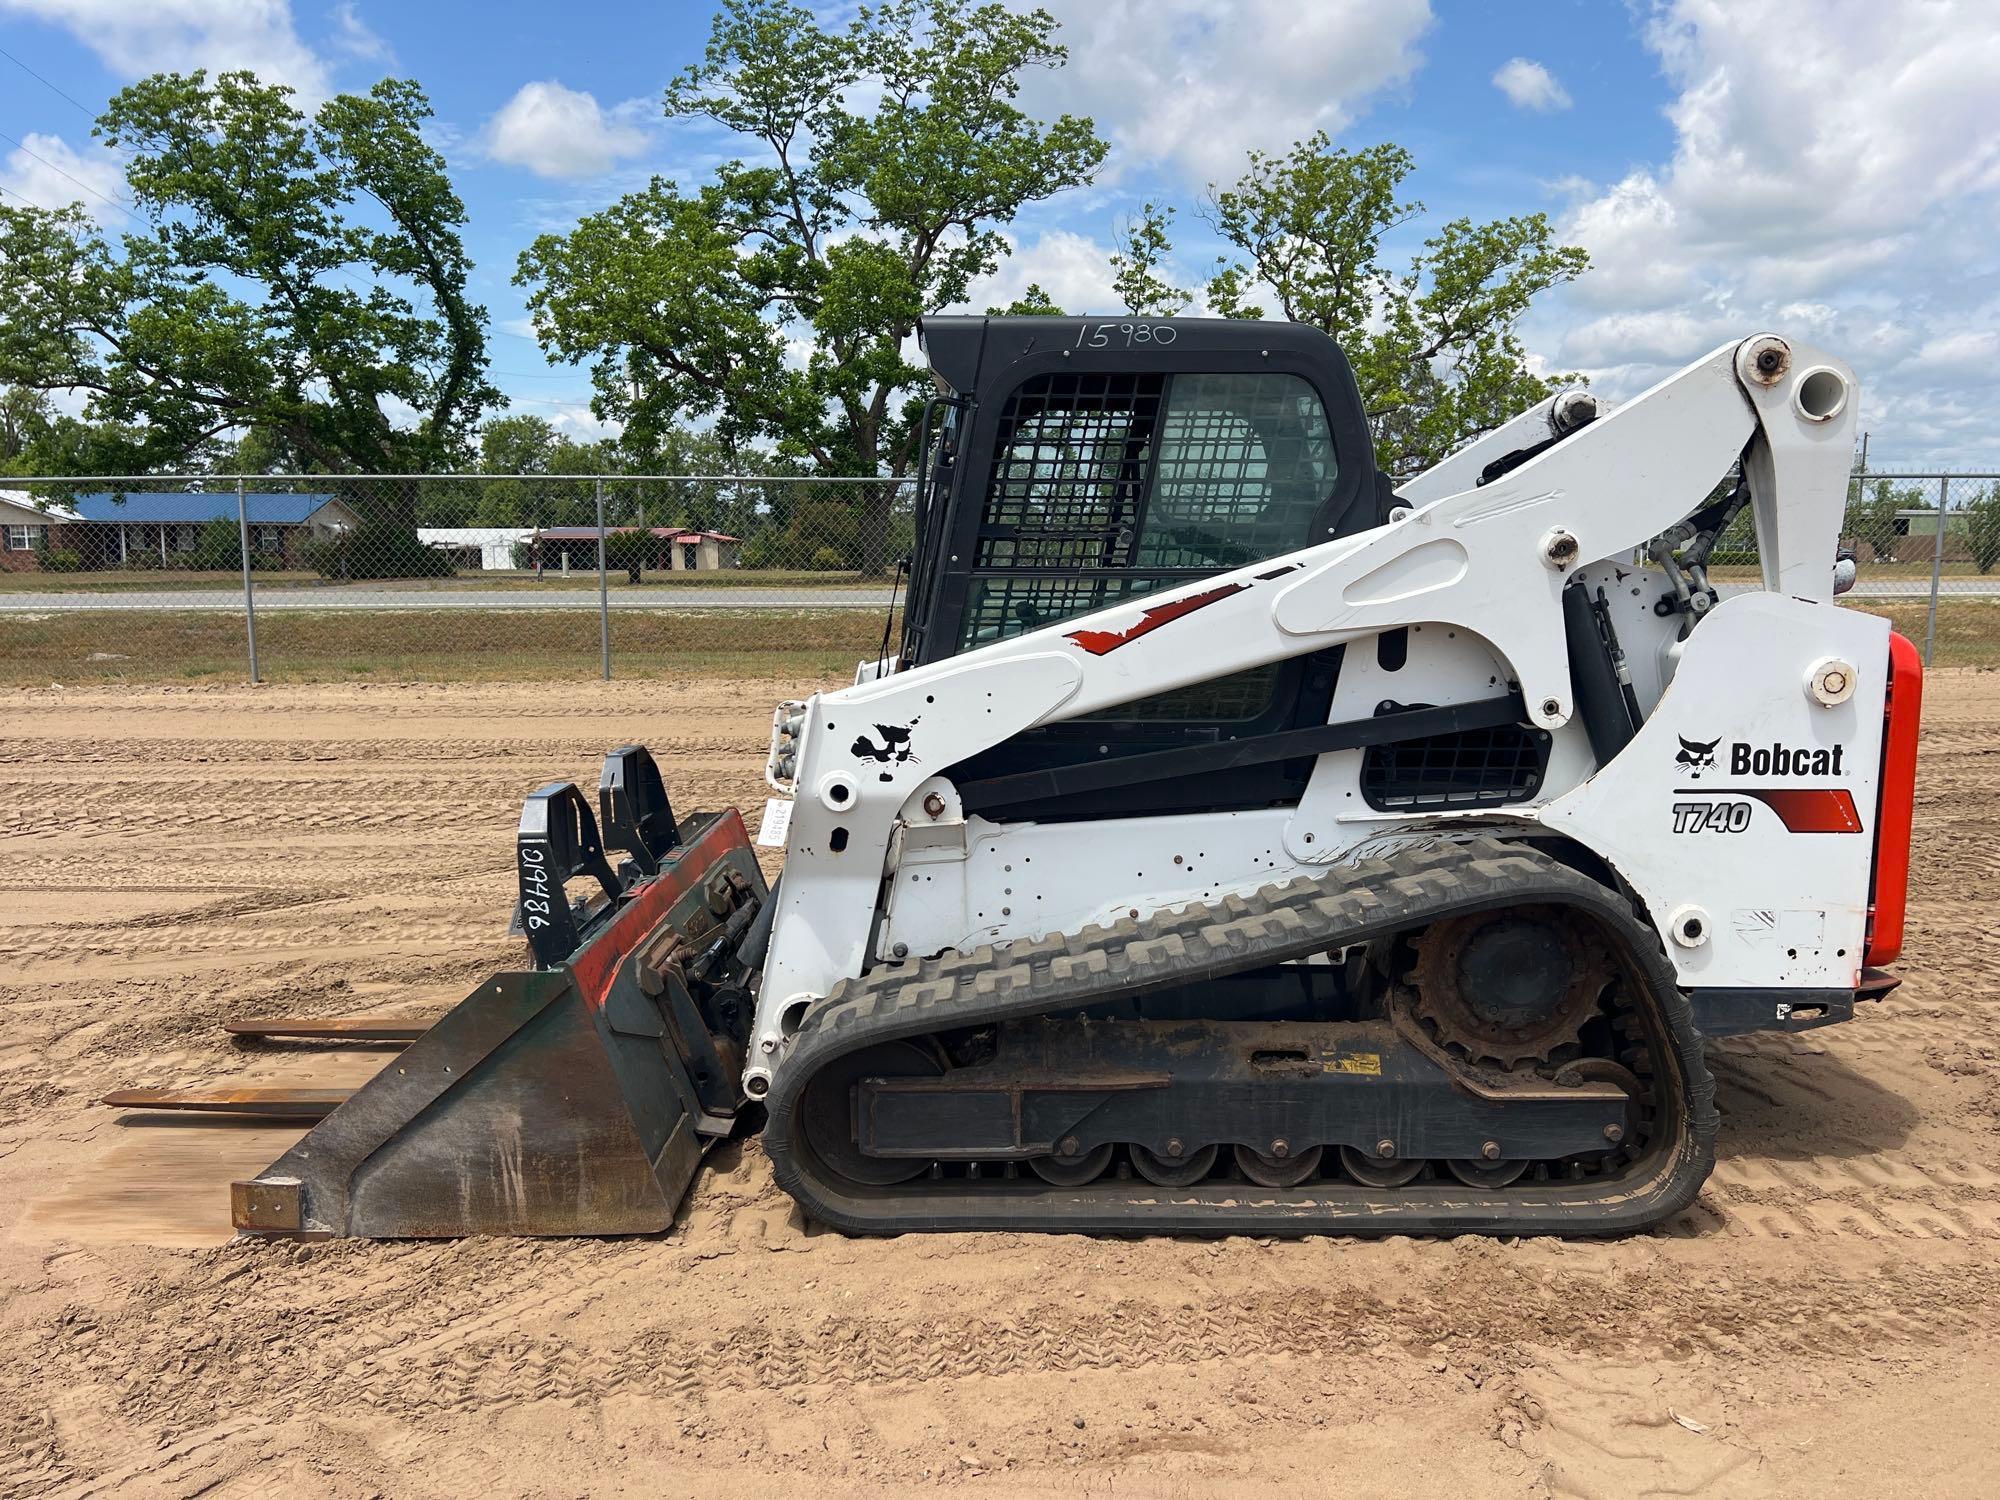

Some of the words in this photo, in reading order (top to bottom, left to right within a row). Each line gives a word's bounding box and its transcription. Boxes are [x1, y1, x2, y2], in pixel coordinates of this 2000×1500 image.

[1075, 323, 1177, 348] 15980
[1730, 742, 1844, 775] Bobcat
[1672, 802, 1752, 833] T740
